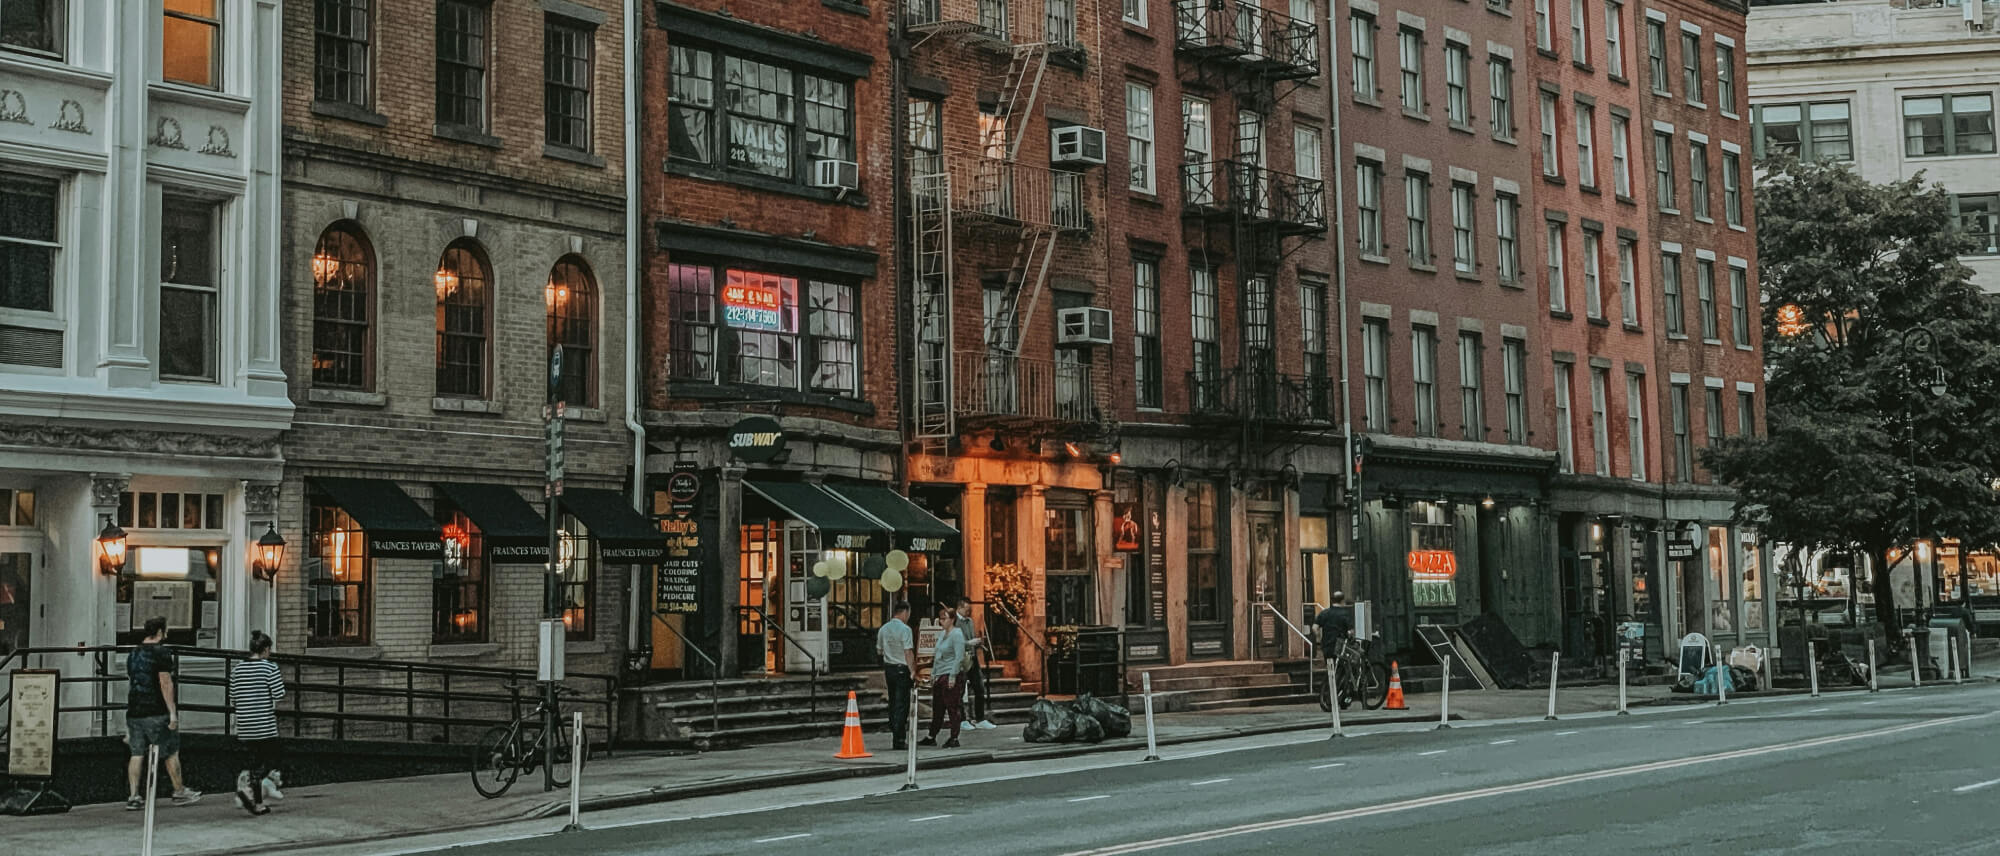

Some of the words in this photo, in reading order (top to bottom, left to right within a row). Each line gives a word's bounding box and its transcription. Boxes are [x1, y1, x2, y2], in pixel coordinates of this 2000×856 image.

[731, 119, 787, 152] NAILS
[731, 147, 746, 162] 212
[729, 432, 782, 448] SUBWAY
[660, 518, 698, 536] Nelly's
[411, 541, 441, 551] TAVERN
[834, 534, 872, 548] SUBWAY
[910, 537, 946, 551] SUBWAY
[493, 546, 529, 555] FRAUNCES
[530, 546, 550, 555] TAVER
[602, 548, 636, 557] FRAUNCES
[681, 560, 699, 568] CUTS
[1411, 552, 1453, 573] PIZZA
[663, 568, 698, 576] COLORING
[663, 576, 689, 584] WAXING
[663, 584, 697, 592] MANICURE
[1413, 583, 1455, 602] PASTA
[662, 592, 695, 601] PEDICURE
